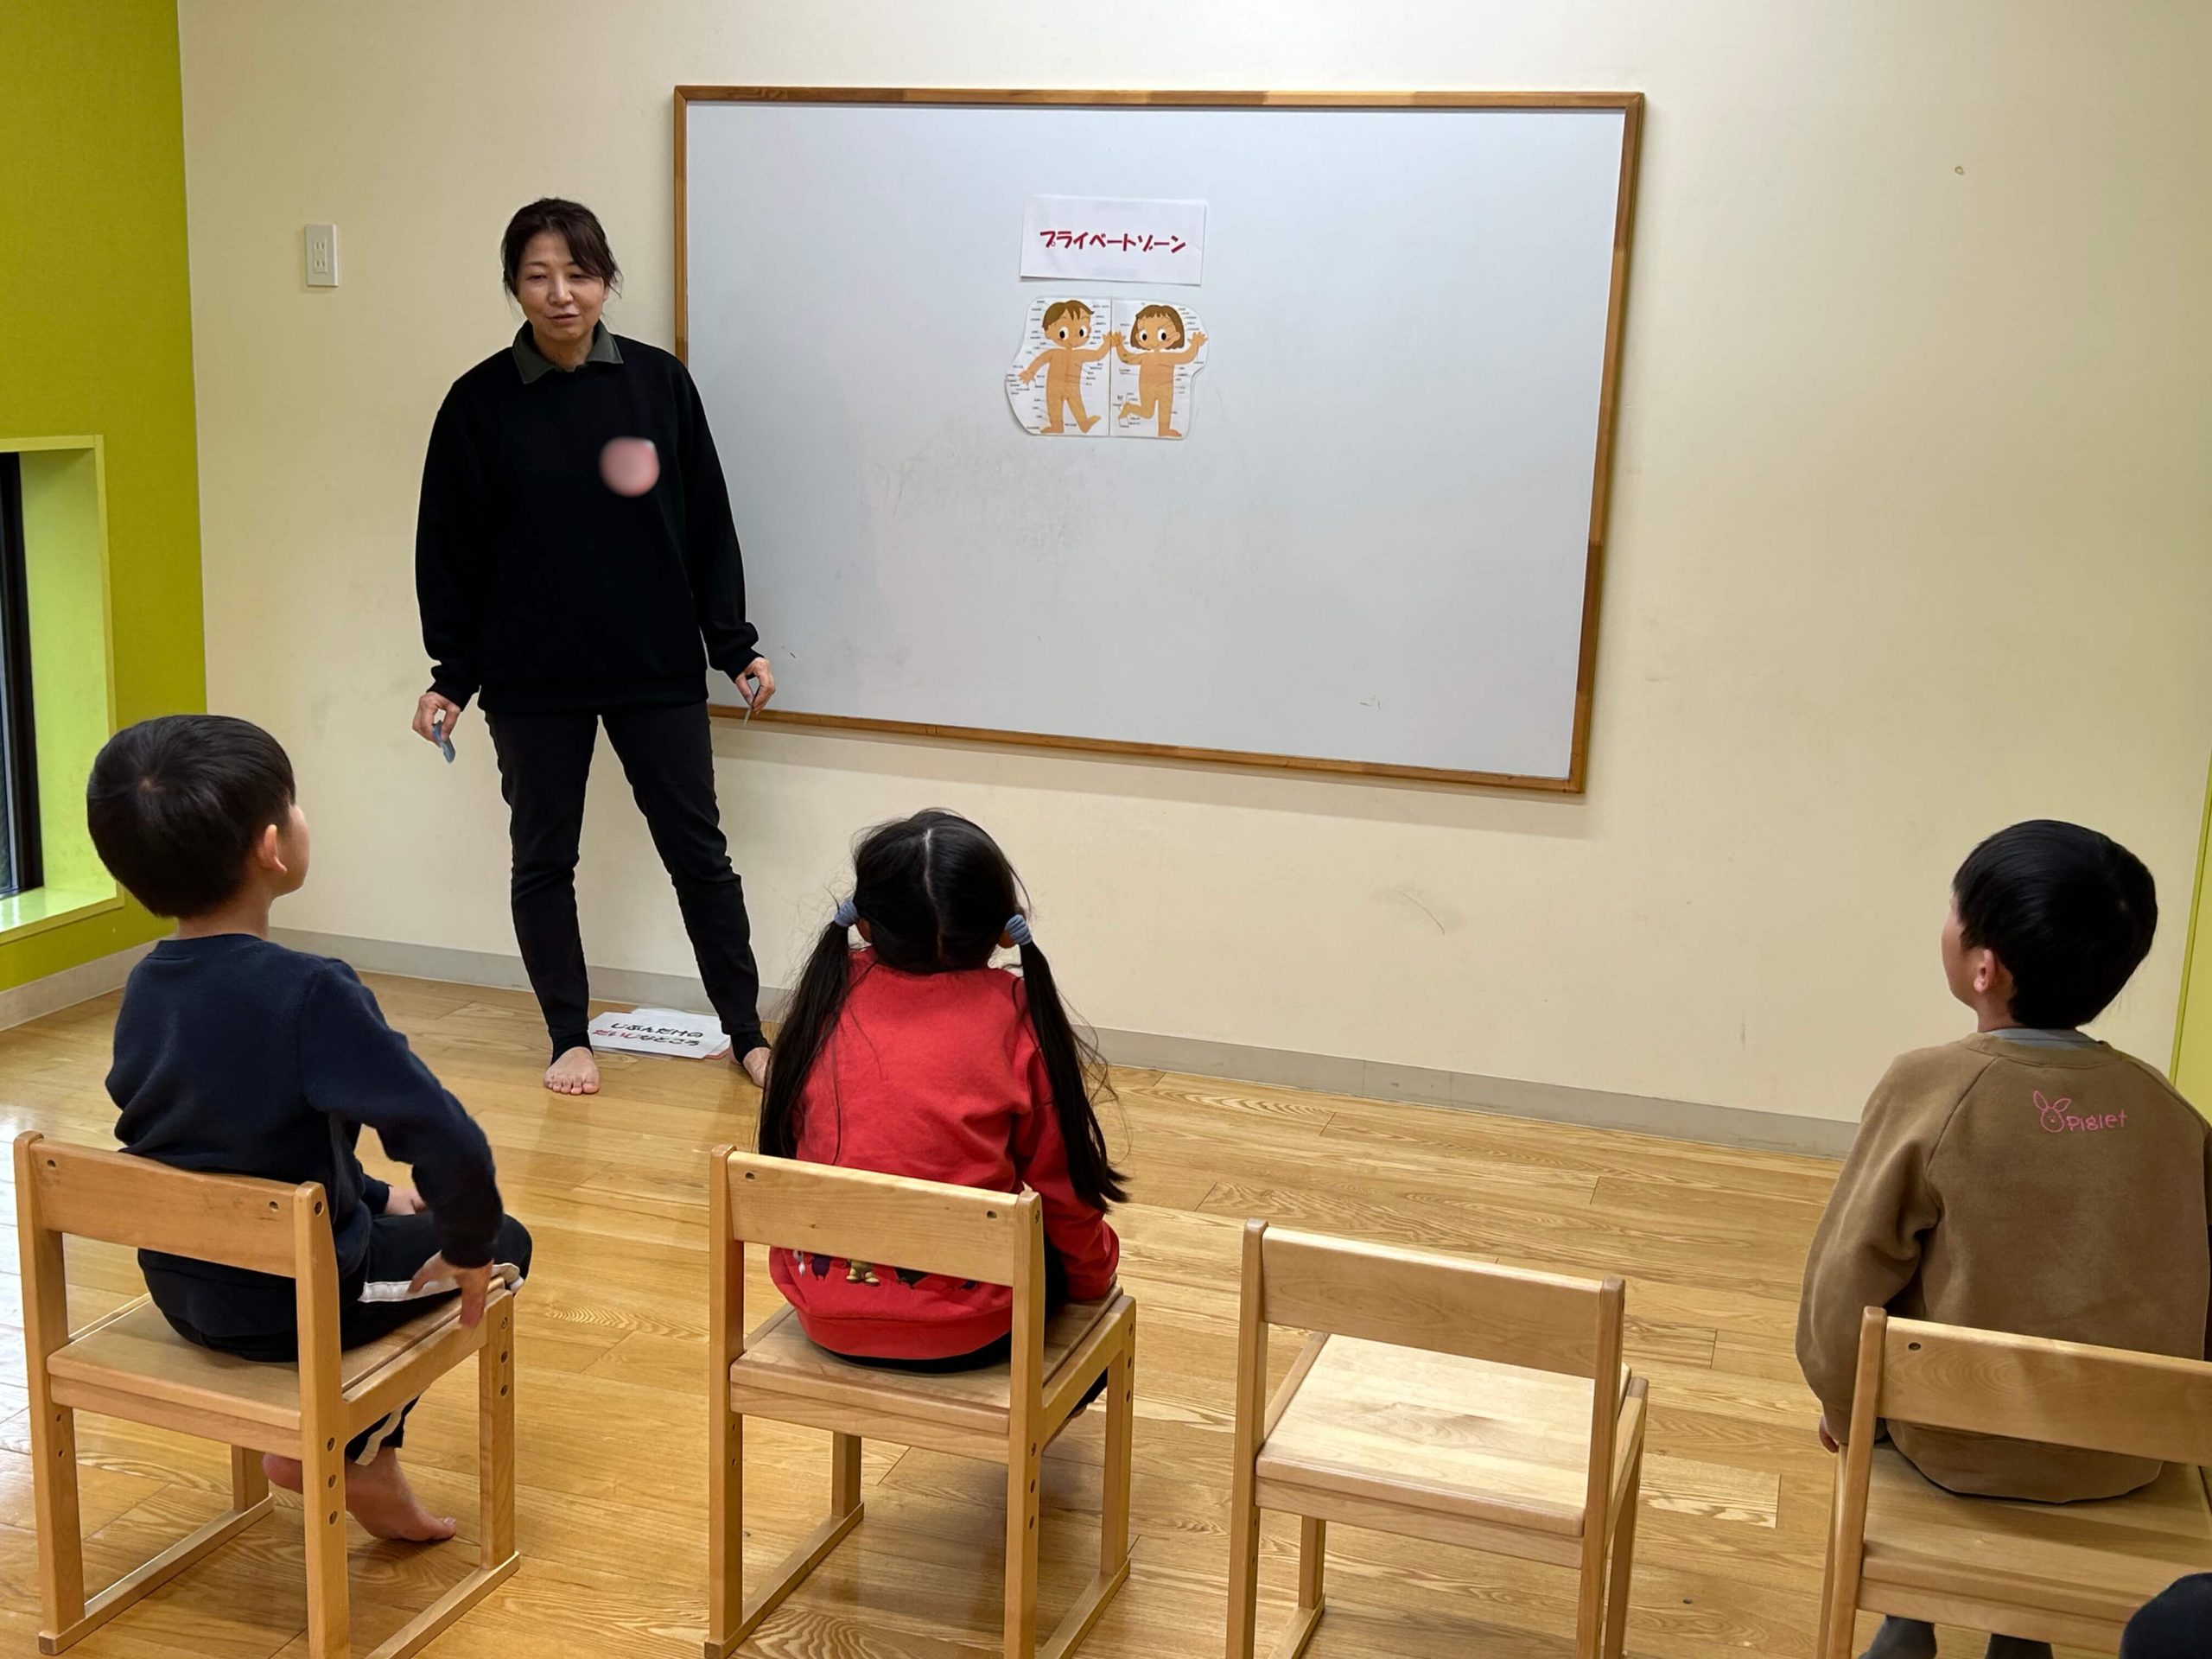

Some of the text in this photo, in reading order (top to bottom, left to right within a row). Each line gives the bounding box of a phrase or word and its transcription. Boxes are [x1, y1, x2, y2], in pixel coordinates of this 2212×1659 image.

[1039, 230, 1186, 254] プライベートゾーン
[2066, 1109, 2128, 1132] Piglet
